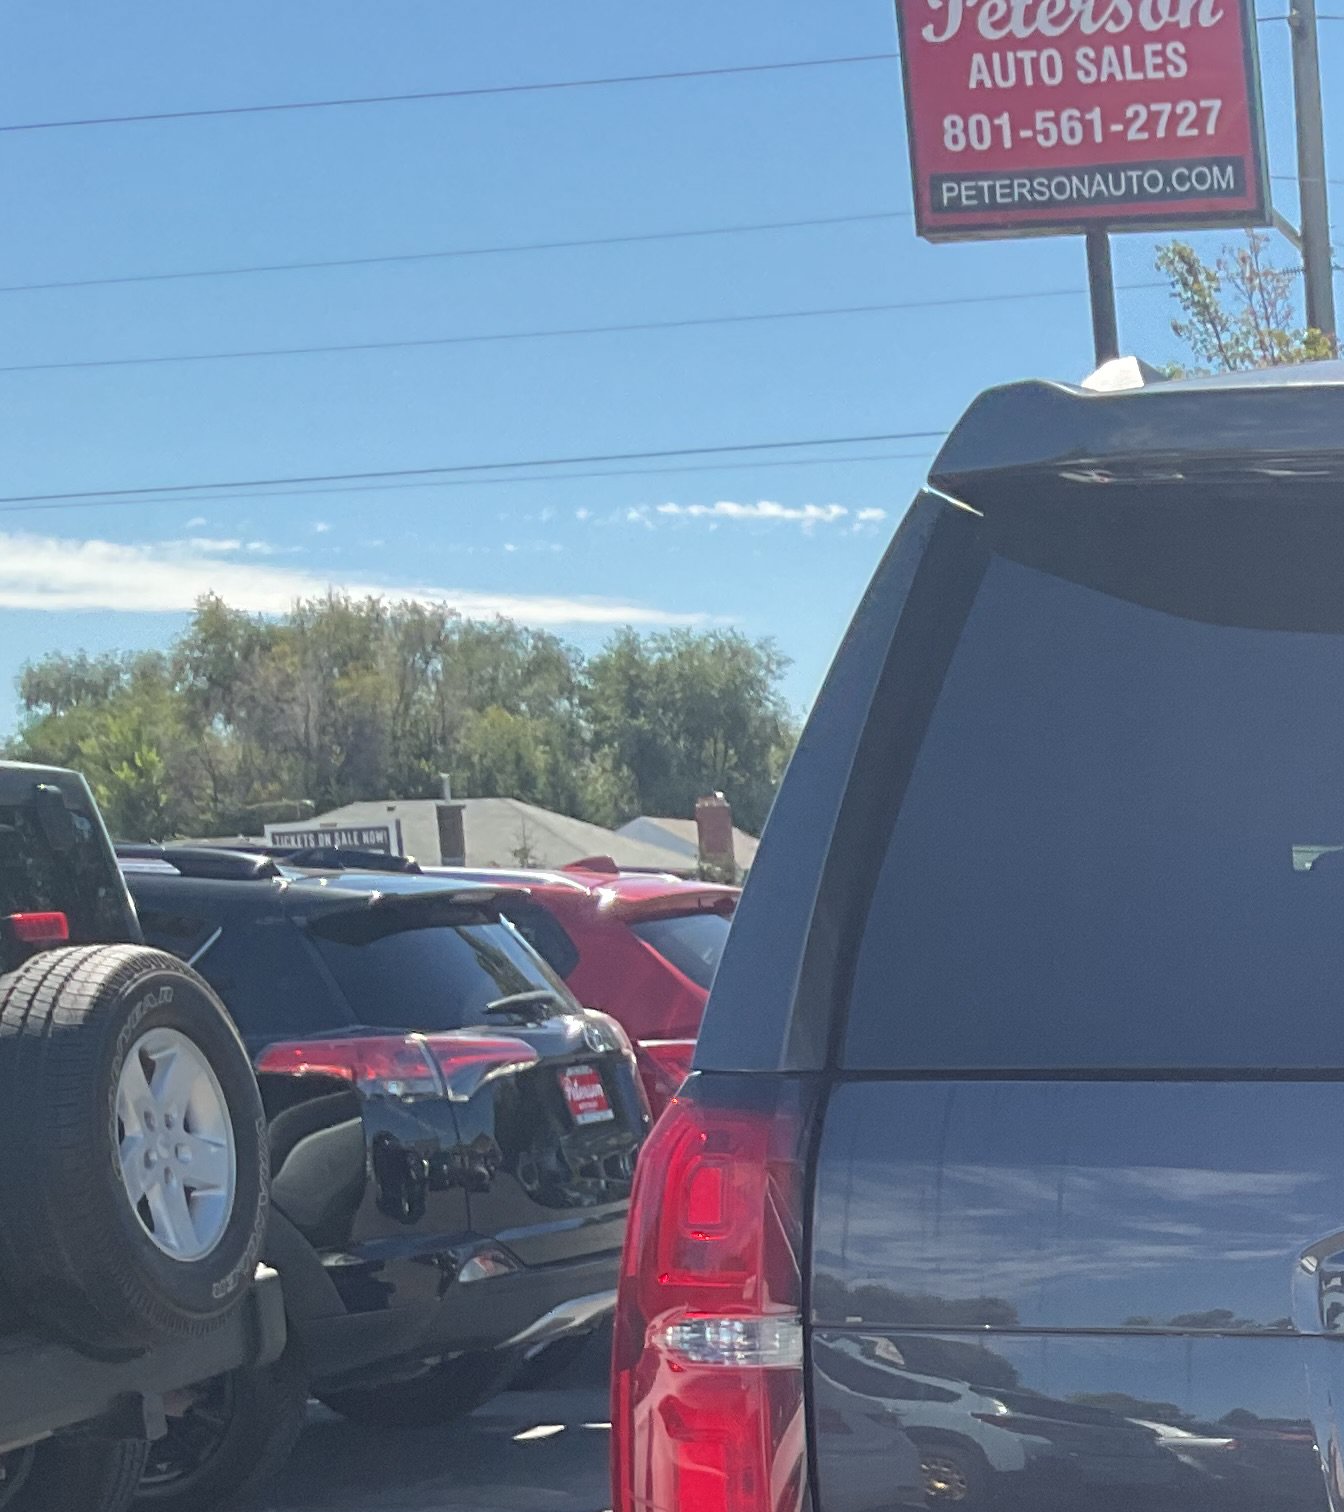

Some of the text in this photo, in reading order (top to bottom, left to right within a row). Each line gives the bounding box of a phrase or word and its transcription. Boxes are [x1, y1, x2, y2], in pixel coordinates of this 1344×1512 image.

[922, 0, 1224, 43] Peterson
[968, 41, 1188, 90] AUTO SALES
[942, 99, 1223, 153] 801-561-2727
[941, 165, 1235, 208] PETERSONAUTO.COM
[273, 829, 388, 848] TICKETS ON SALE NOW!
